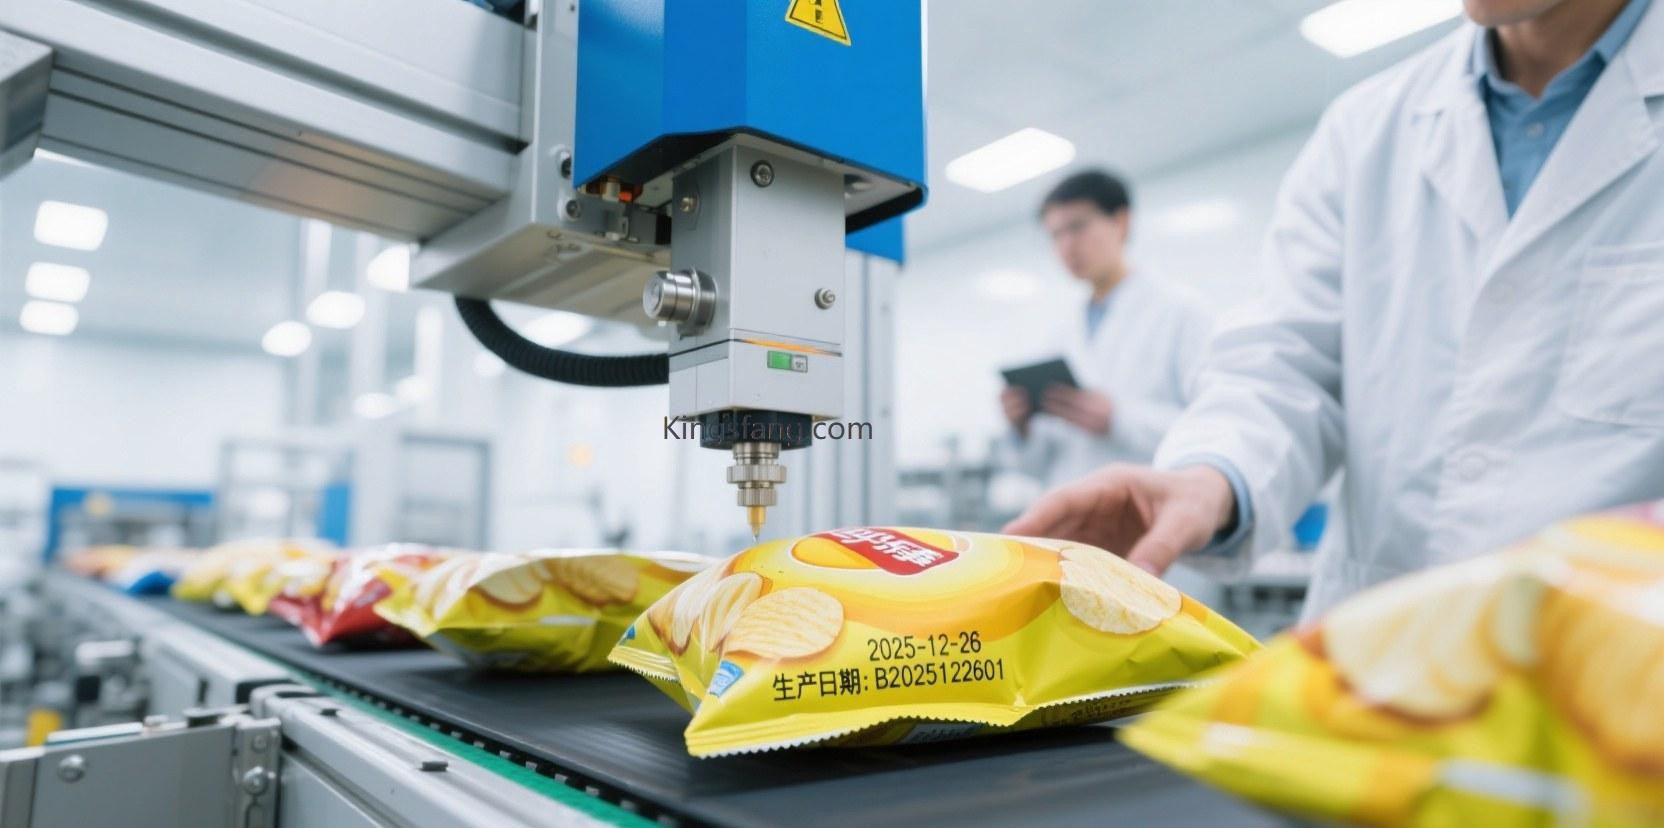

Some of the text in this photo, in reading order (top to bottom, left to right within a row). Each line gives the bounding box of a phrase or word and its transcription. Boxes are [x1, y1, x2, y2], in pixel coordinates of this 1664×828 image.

[867, 631, 982, 661] 2025-12-26
[773, 668, 869, 701] 生产日期:
[875, 658, 1005, 690] B2025122601
